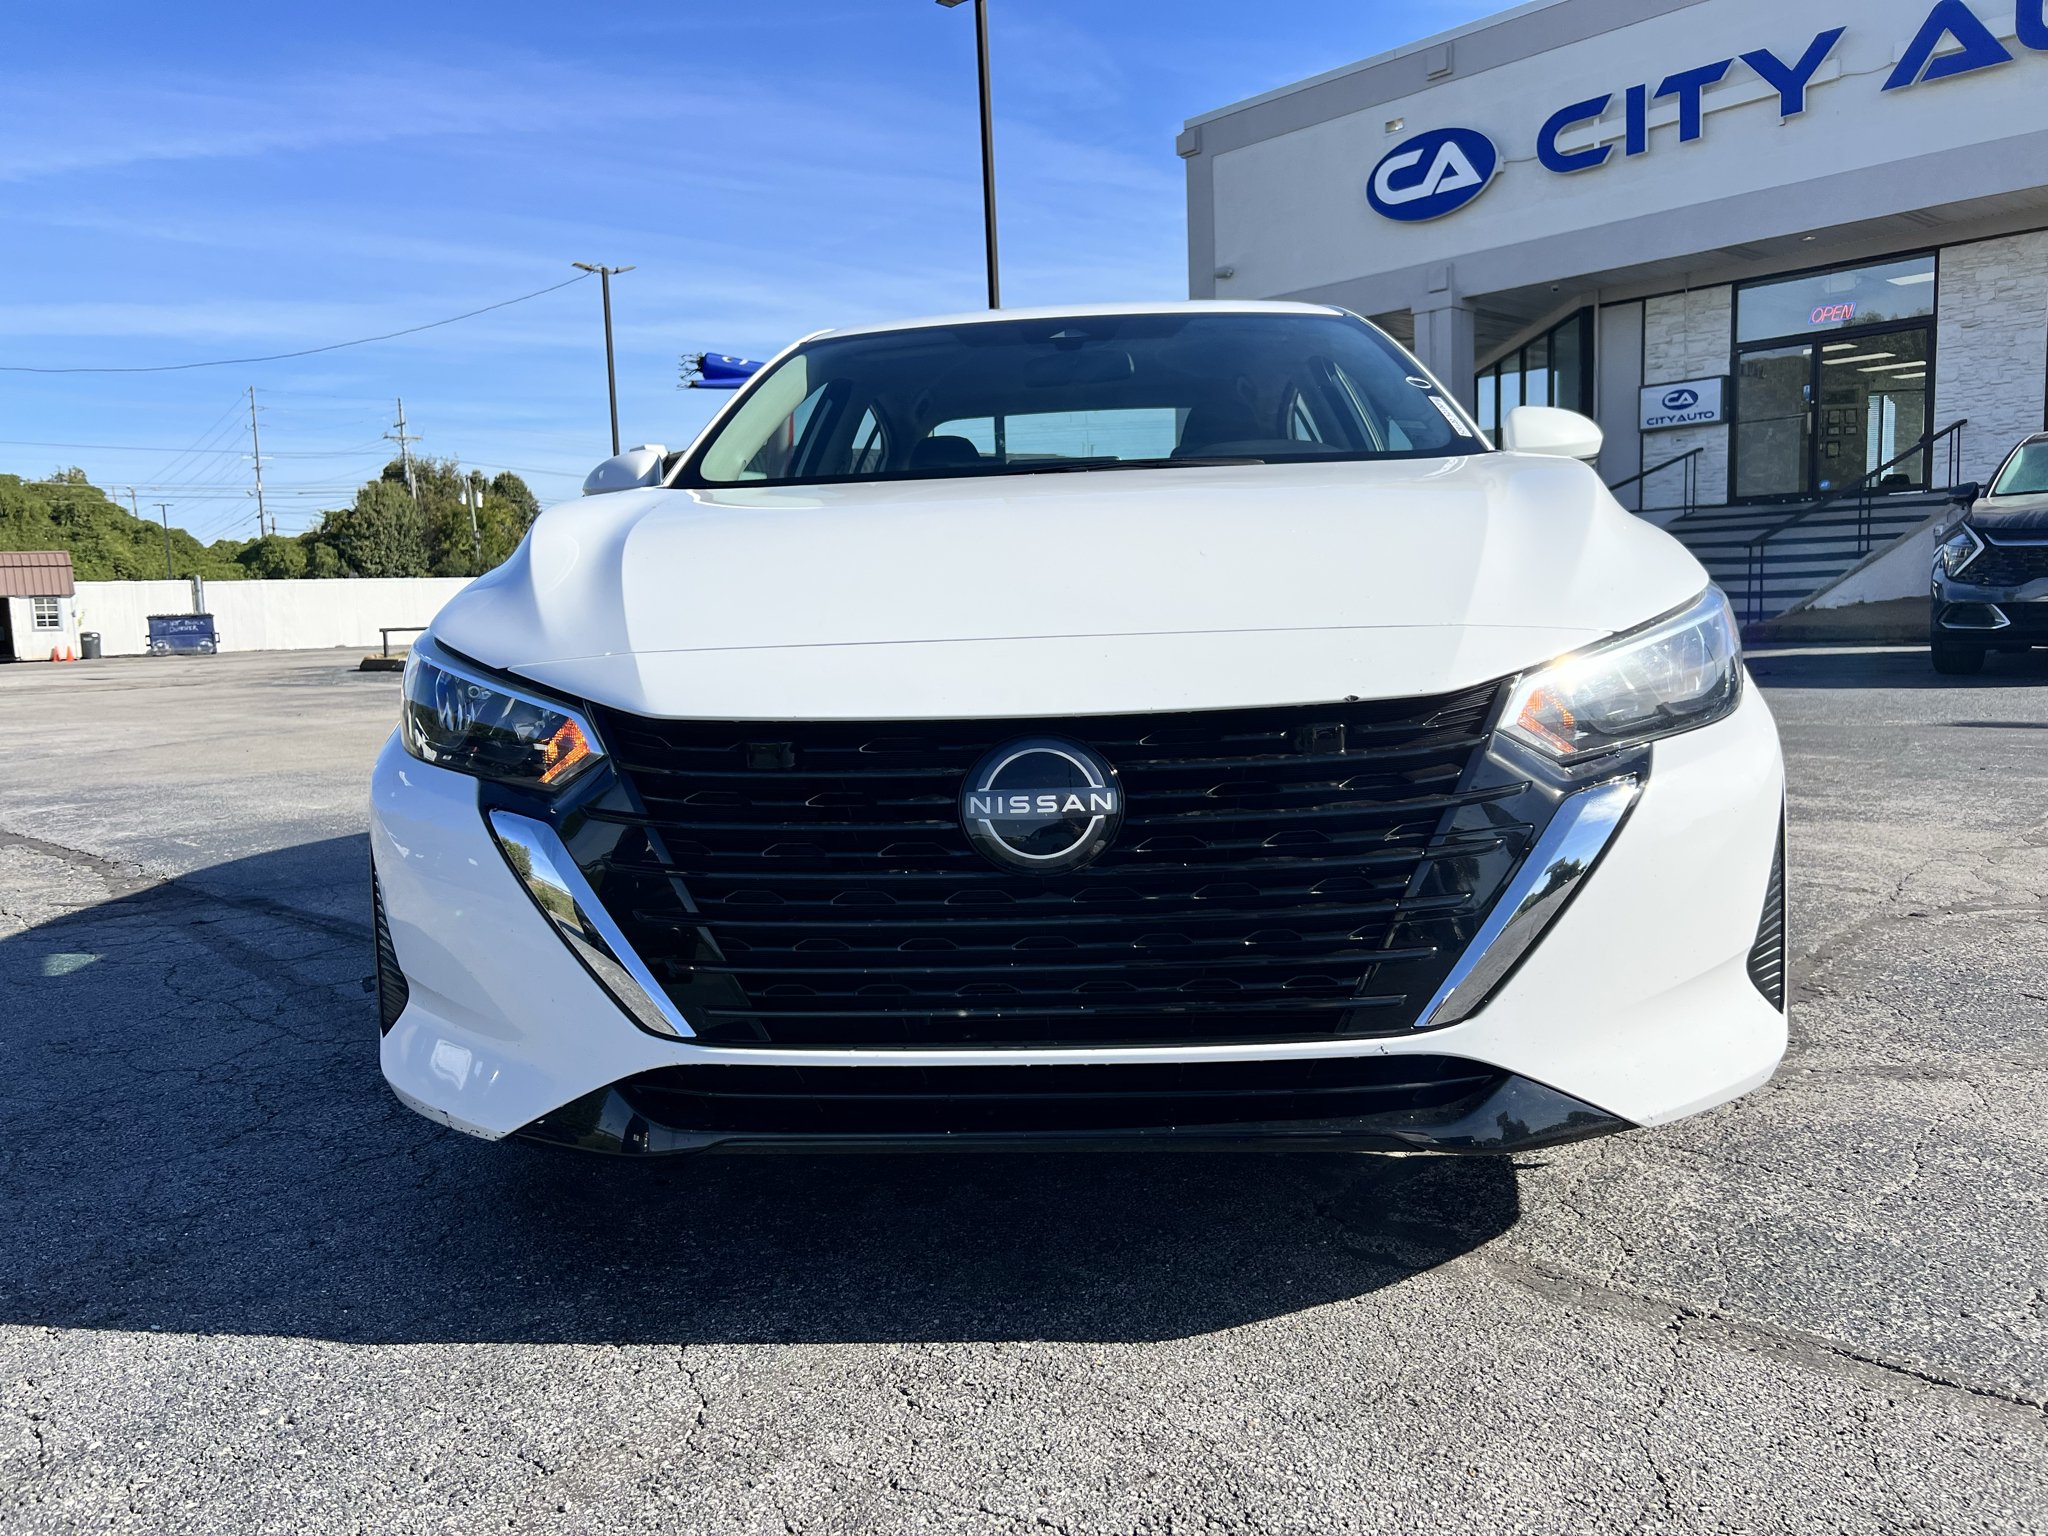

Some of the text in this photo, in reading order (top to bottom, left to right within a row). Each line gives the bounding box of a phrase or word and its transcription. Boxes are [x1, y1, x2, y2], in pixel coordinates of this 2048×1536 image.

[1374, 0, 2048, 206] CA CITY A
[1811, 303, 1854, 323] OPEN
[1664, 391, 1695, 407] CA
[970, 792, 1112, 814] NISSAN
